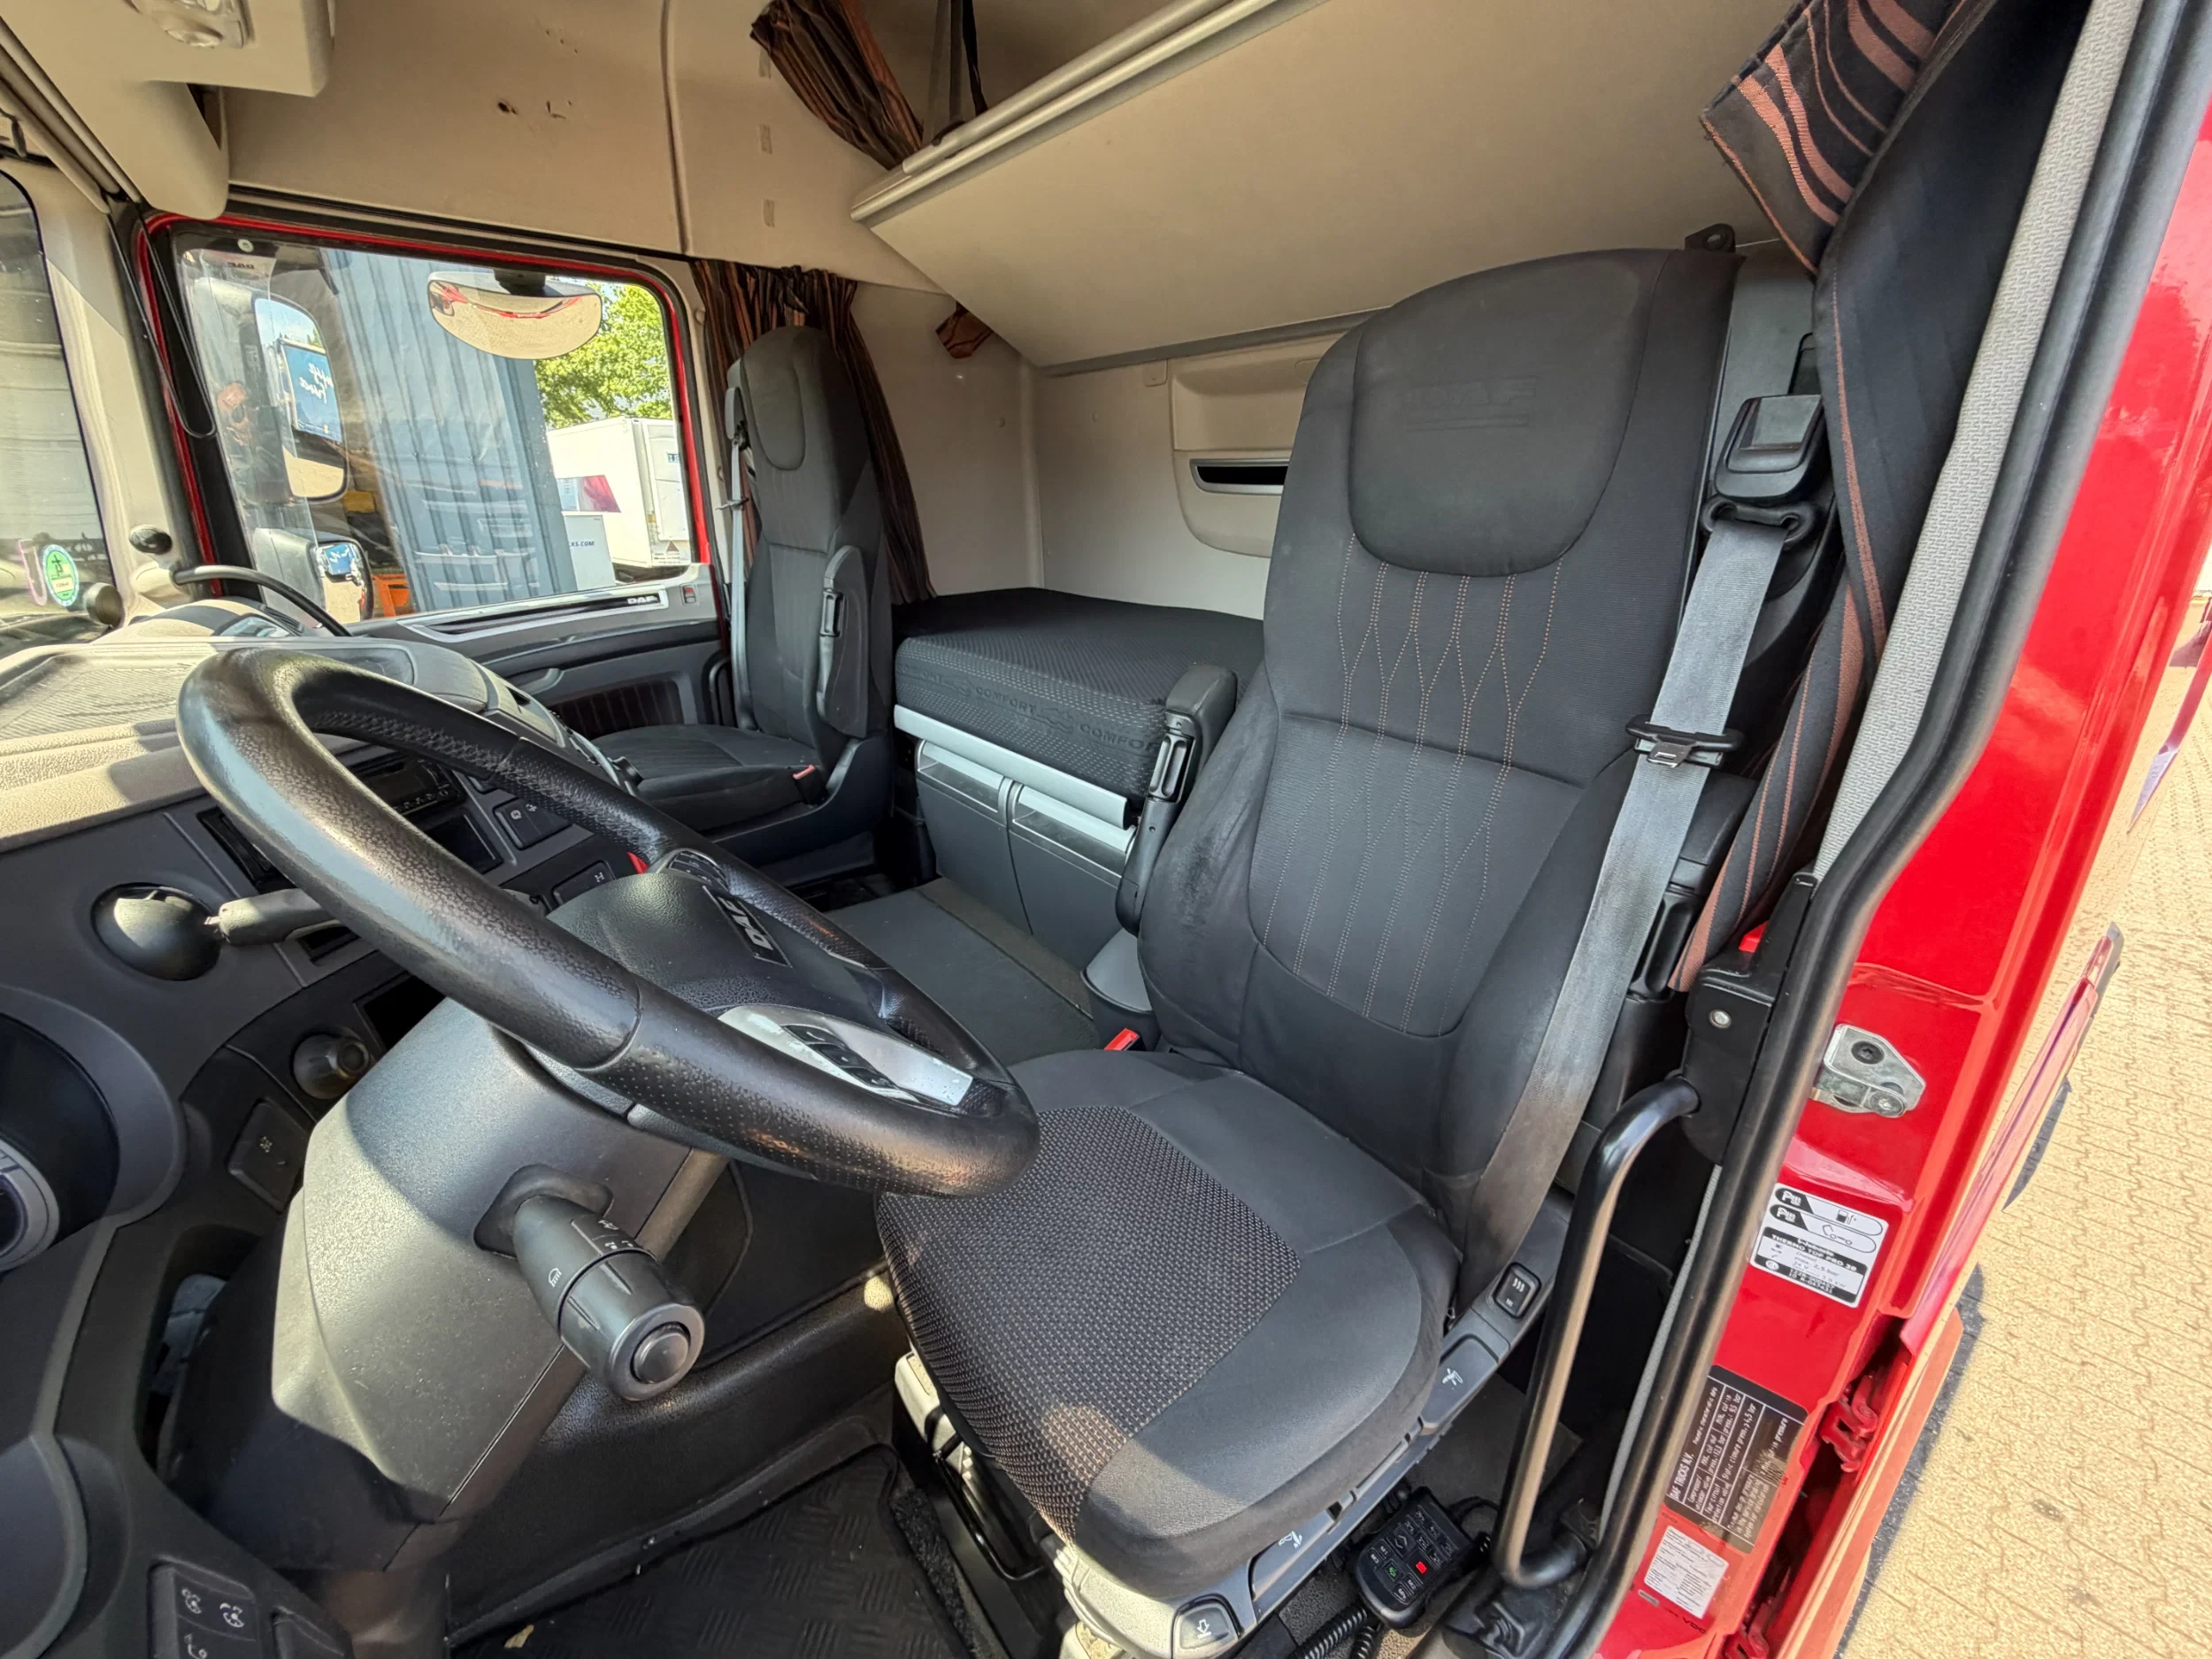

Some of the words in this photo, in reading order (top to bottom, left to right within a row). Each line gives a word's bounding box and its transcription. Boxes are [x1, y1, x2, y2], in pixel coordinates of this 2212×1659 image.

[627, 595, 658, 605] DAF
[975, 686, 1038, 714] COMFORT
[718, 896, 774, 951] DAF
[1771, 1234, 1805, 1252] THERMO
[1808, 1248, 1824, 1259] TOP
[1824, 1256, 1845, 1267] PRO
[1732, 1393, 1742, 1404] bar
[1747, 1402, 1757, 1415] bar
[1773, 1417, 1789, 1443] pressure
[1673, 1463, 1691, 1487] TRUCKS
[1670, 1485, 1682, 1501] DAF
